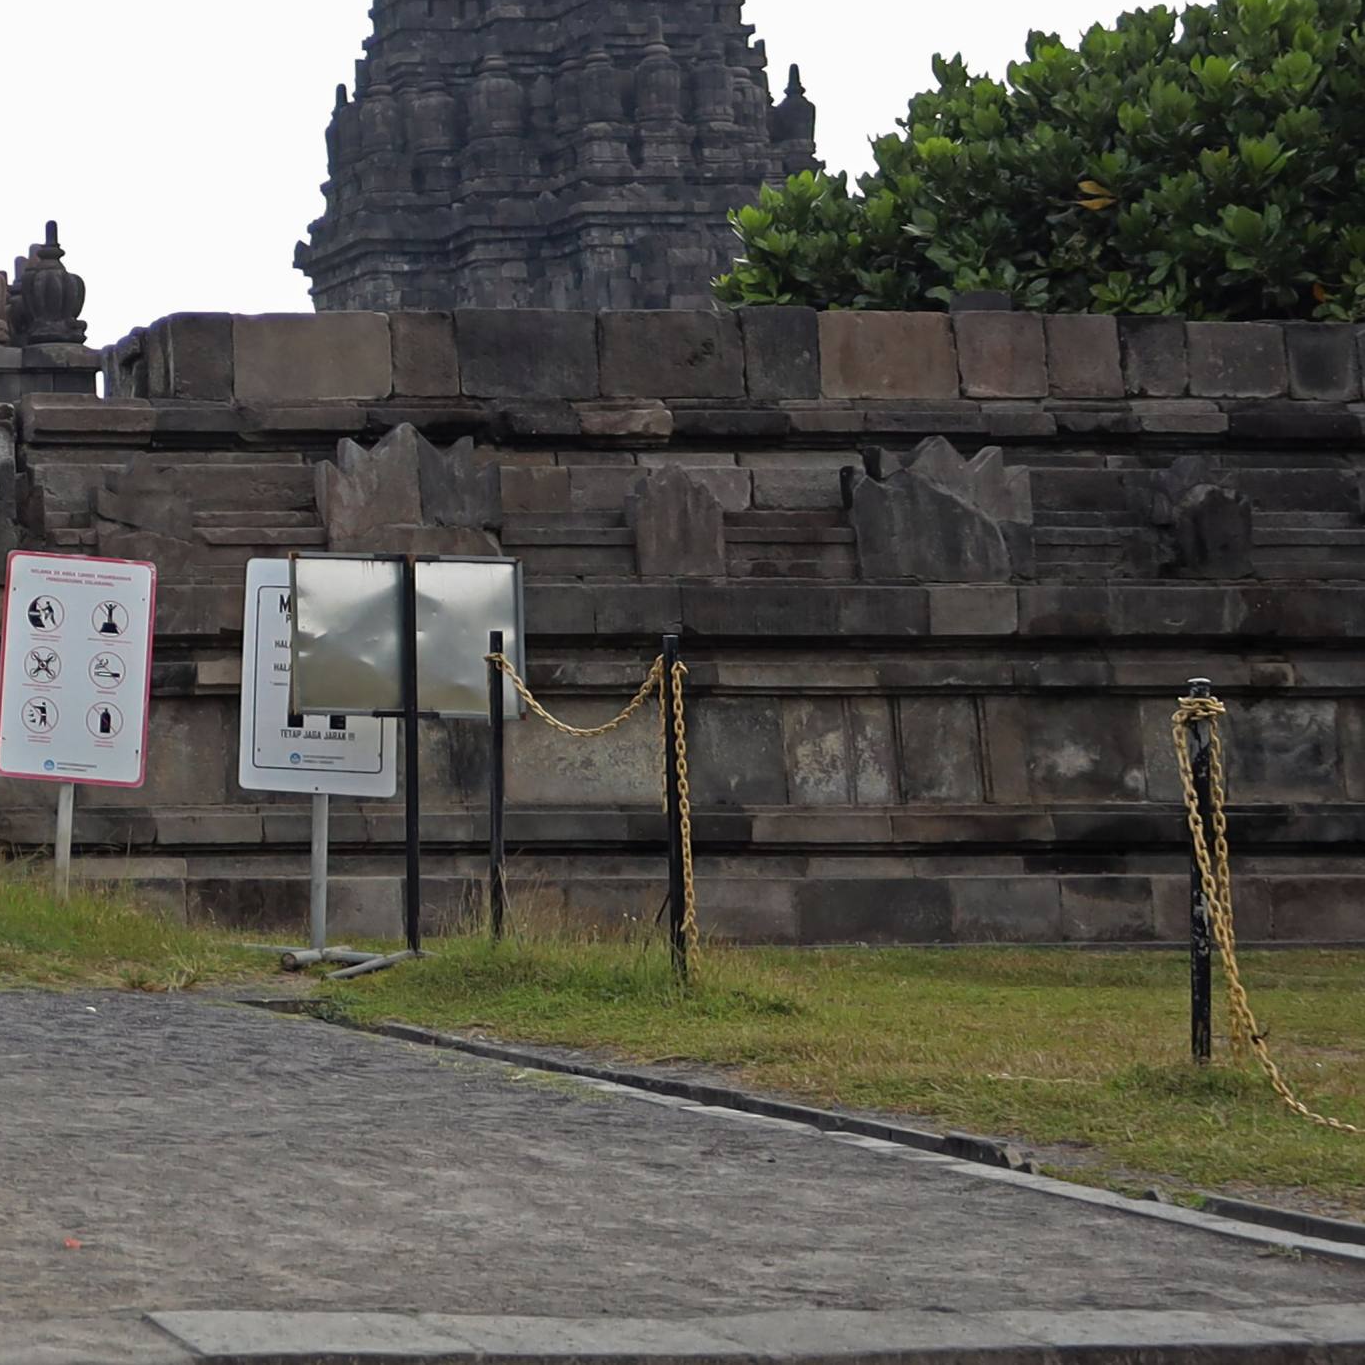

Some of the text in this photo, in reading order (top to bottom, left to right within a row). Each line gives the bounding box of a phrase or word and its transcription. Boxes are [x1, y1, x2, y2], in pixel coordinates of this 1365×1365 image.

[280, 728, 301, 739] TETAP
[303, 730, 322, 740] JAGA
[323, 731, 347, 741] JARAK
